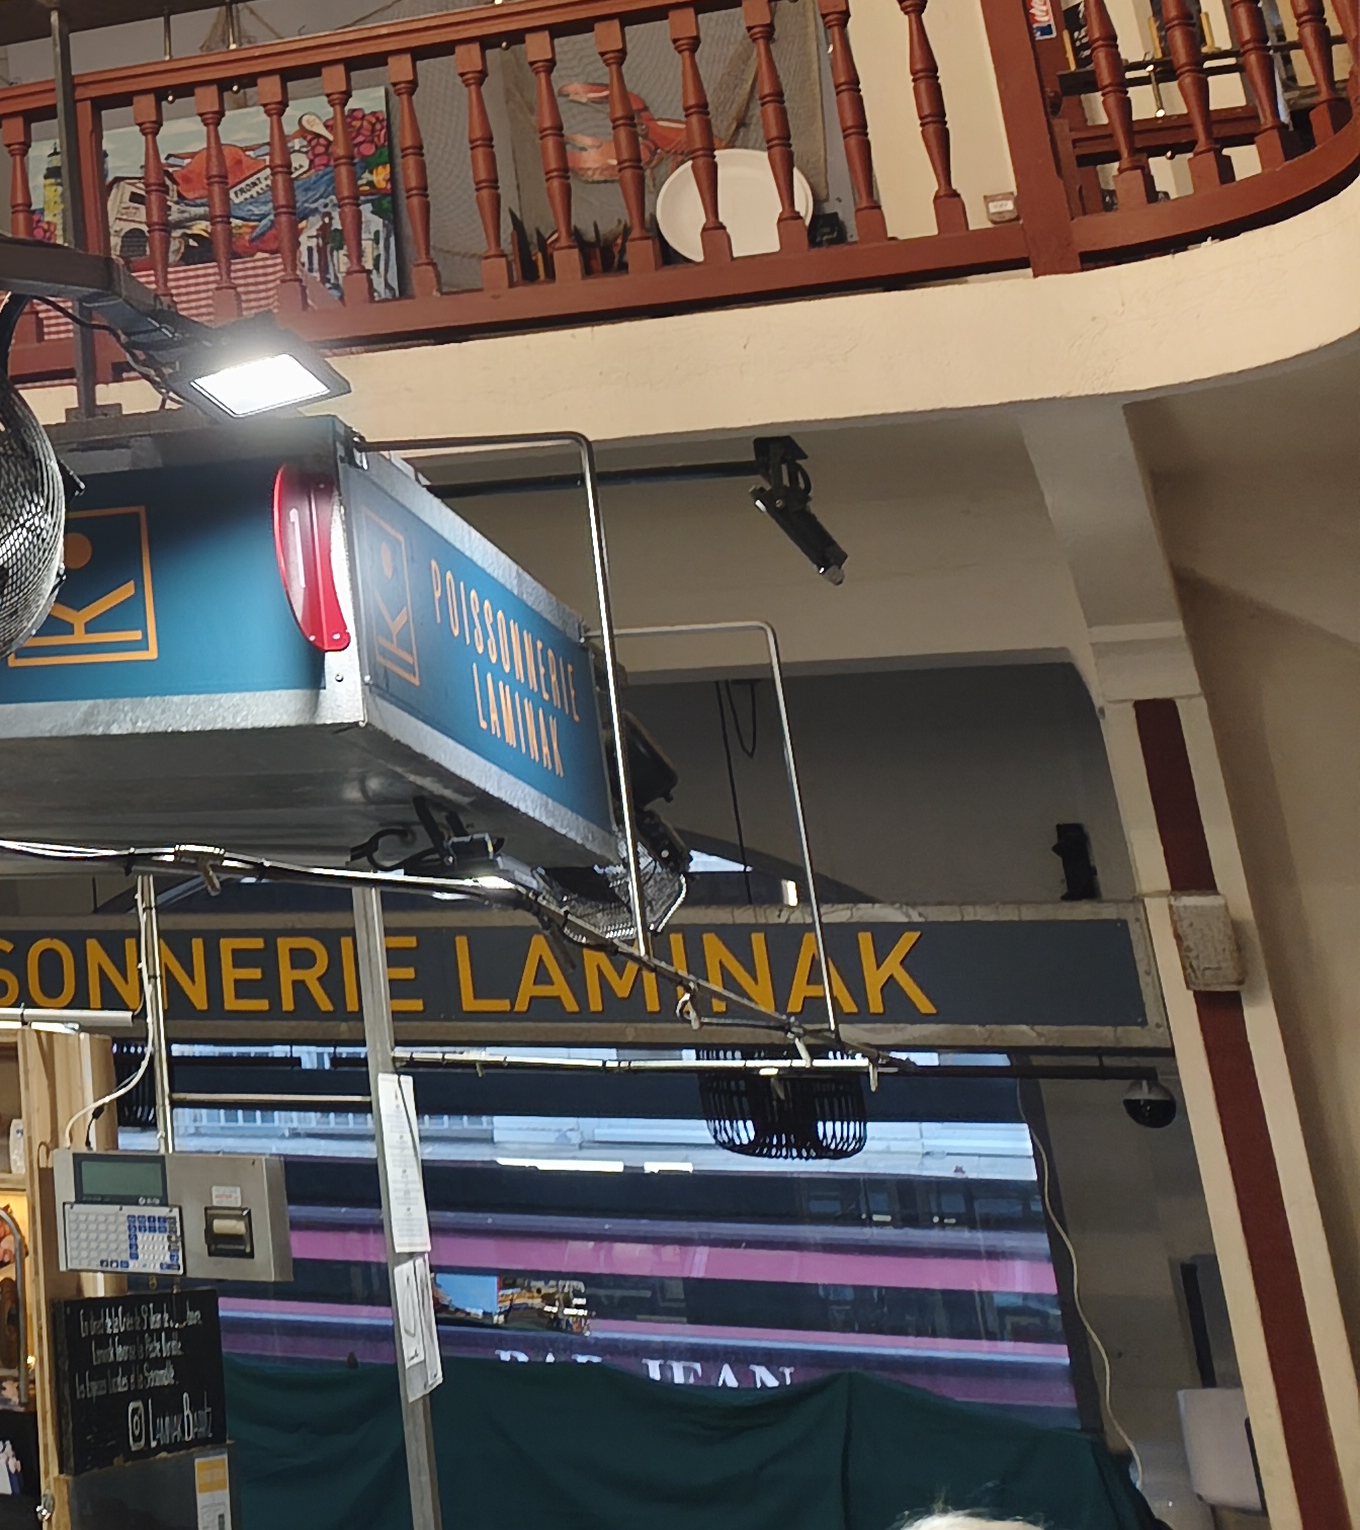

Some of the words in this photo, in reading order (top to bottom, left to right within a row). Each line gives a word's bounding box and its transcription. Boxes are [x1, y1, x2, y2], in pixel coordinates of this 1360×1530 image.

[430, 558, 580, 722] POISSONNERIE
[472, 662, 565, 778] LAMINAK
[454, 931, 939, 1016] LAMINAK
